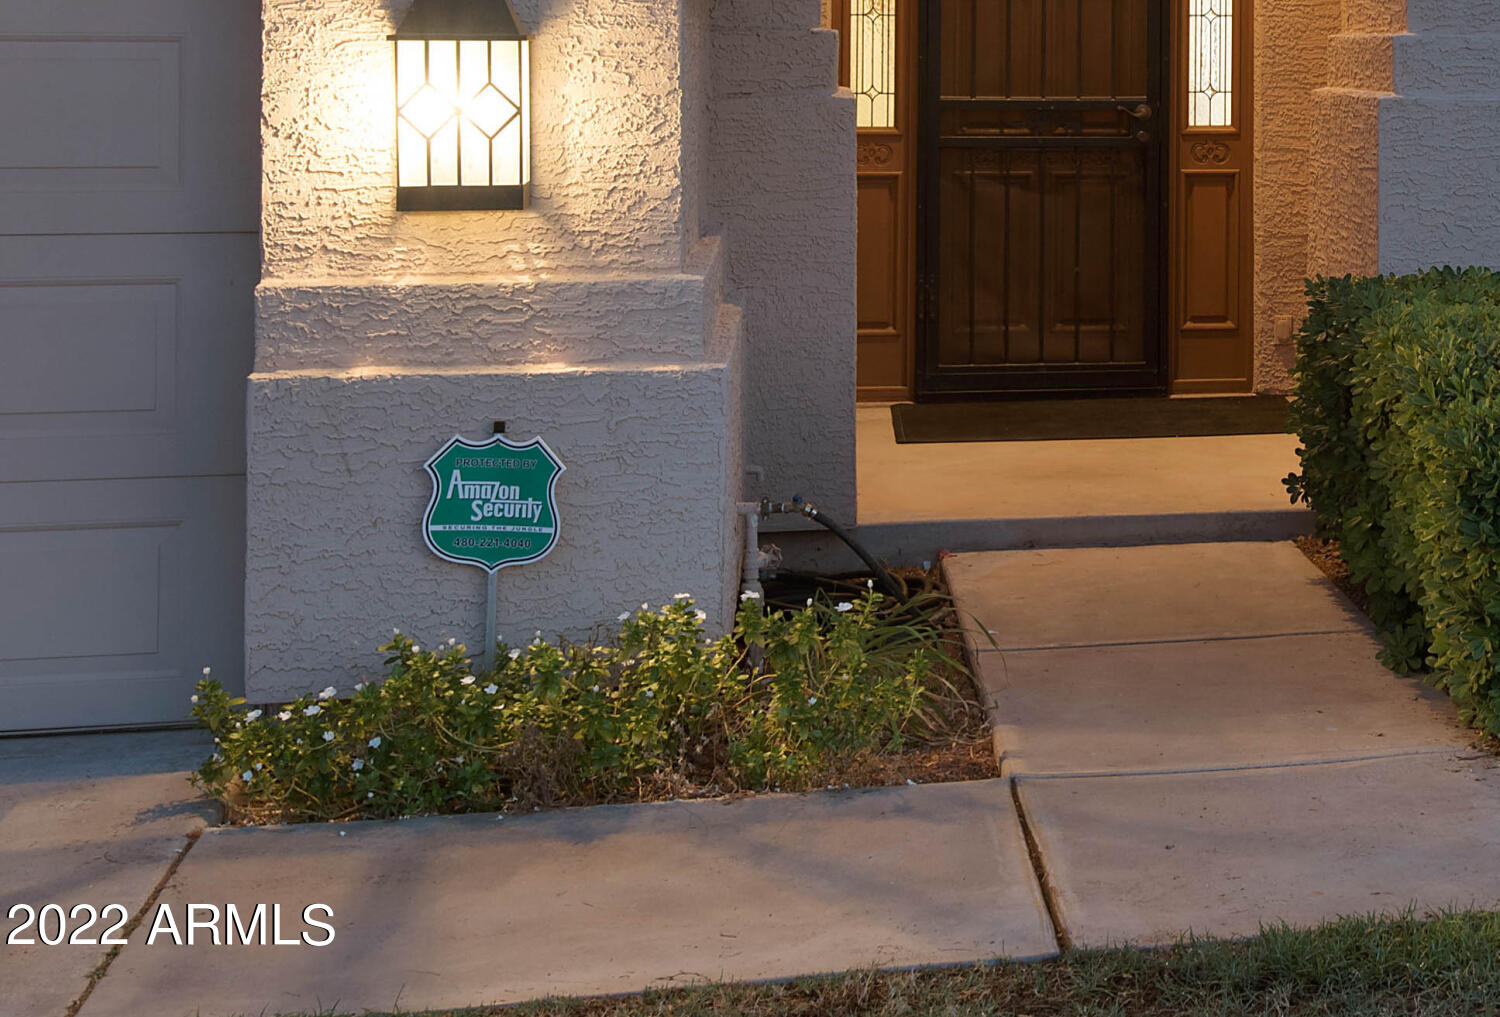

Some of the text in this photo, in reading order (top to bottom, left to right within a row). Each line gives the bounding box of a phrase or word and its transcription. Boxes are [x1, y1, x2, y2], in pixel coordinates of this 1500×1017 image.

[455, 458, 537, 469] PROTECTED BY
[446, 469, 520, 501] Amazon
[470, 498, 542, 523] Security
[453, 537, 531, 549] 480-221-4040
